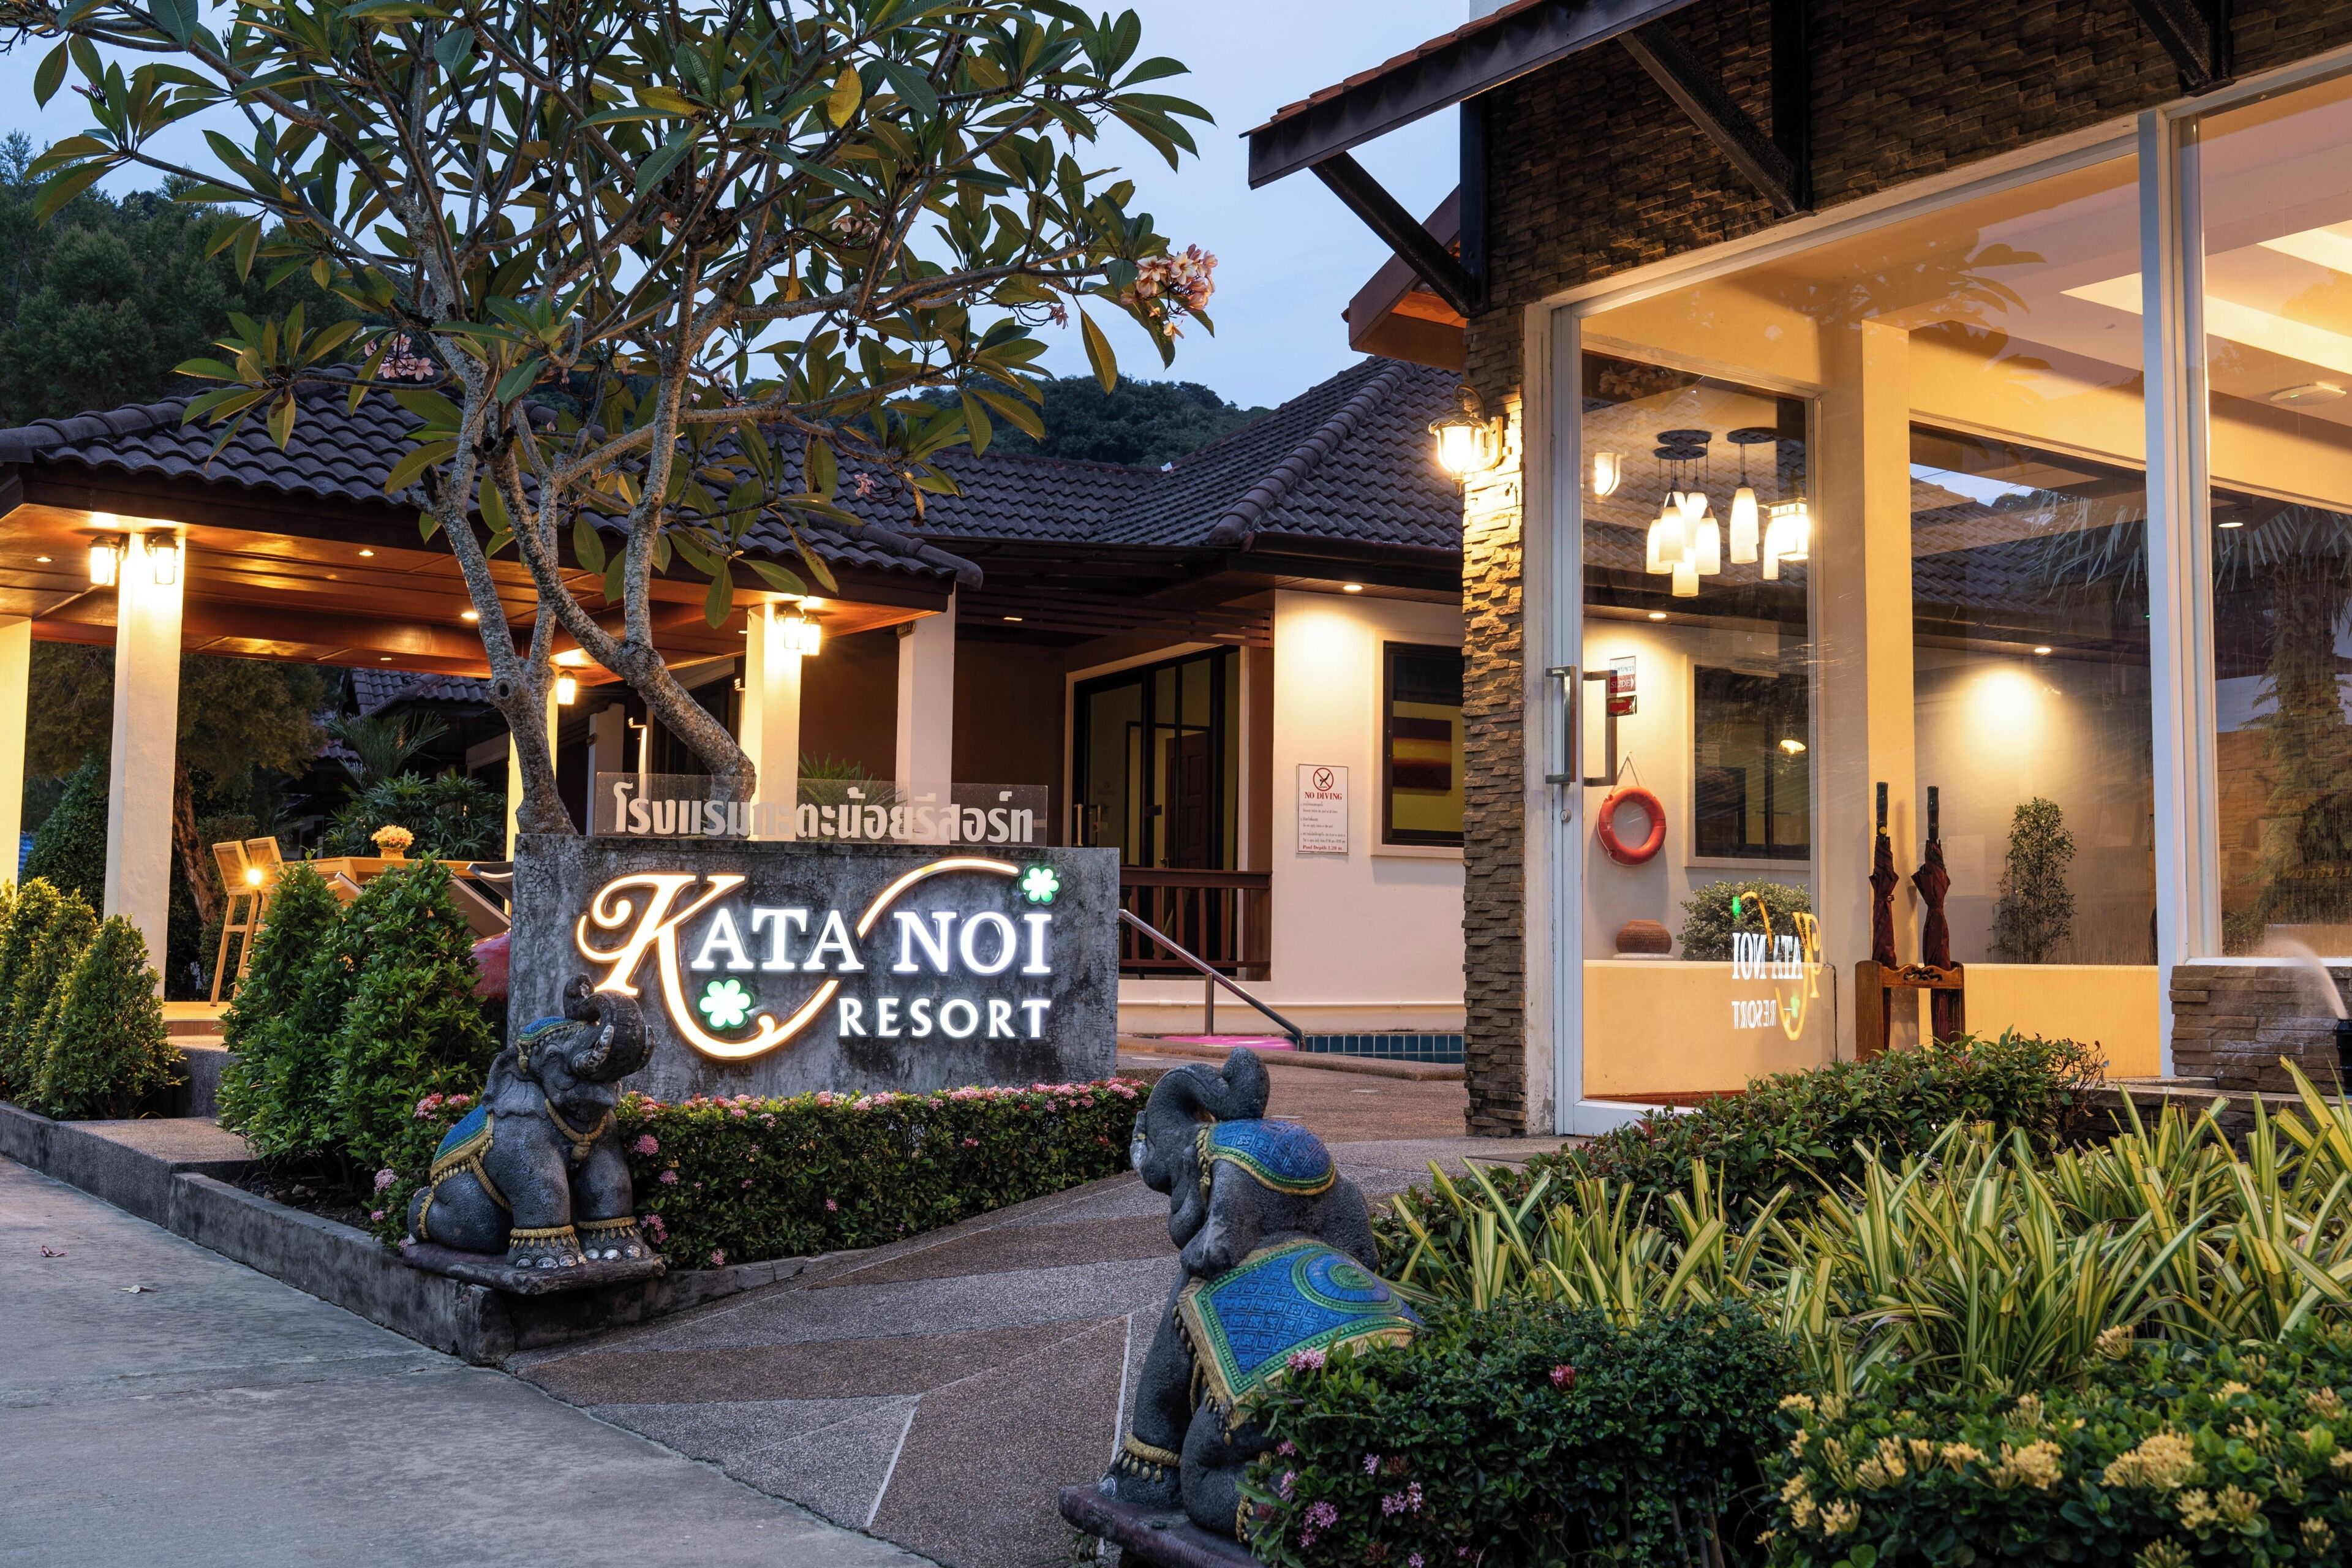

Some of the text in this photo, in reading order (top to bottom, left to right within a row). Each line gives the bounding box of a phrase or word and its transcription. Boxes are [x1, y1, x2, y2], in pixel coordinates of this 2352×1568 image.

[1611, 679, 1630, 688] SLIDE
[613, 782, 1033, 843] โรงแรมกะตะน้อยรีสอร์ท
[575, 872, 1053, 1058] KATA NOI
[838, 997, 1052, 1039] RESORT
